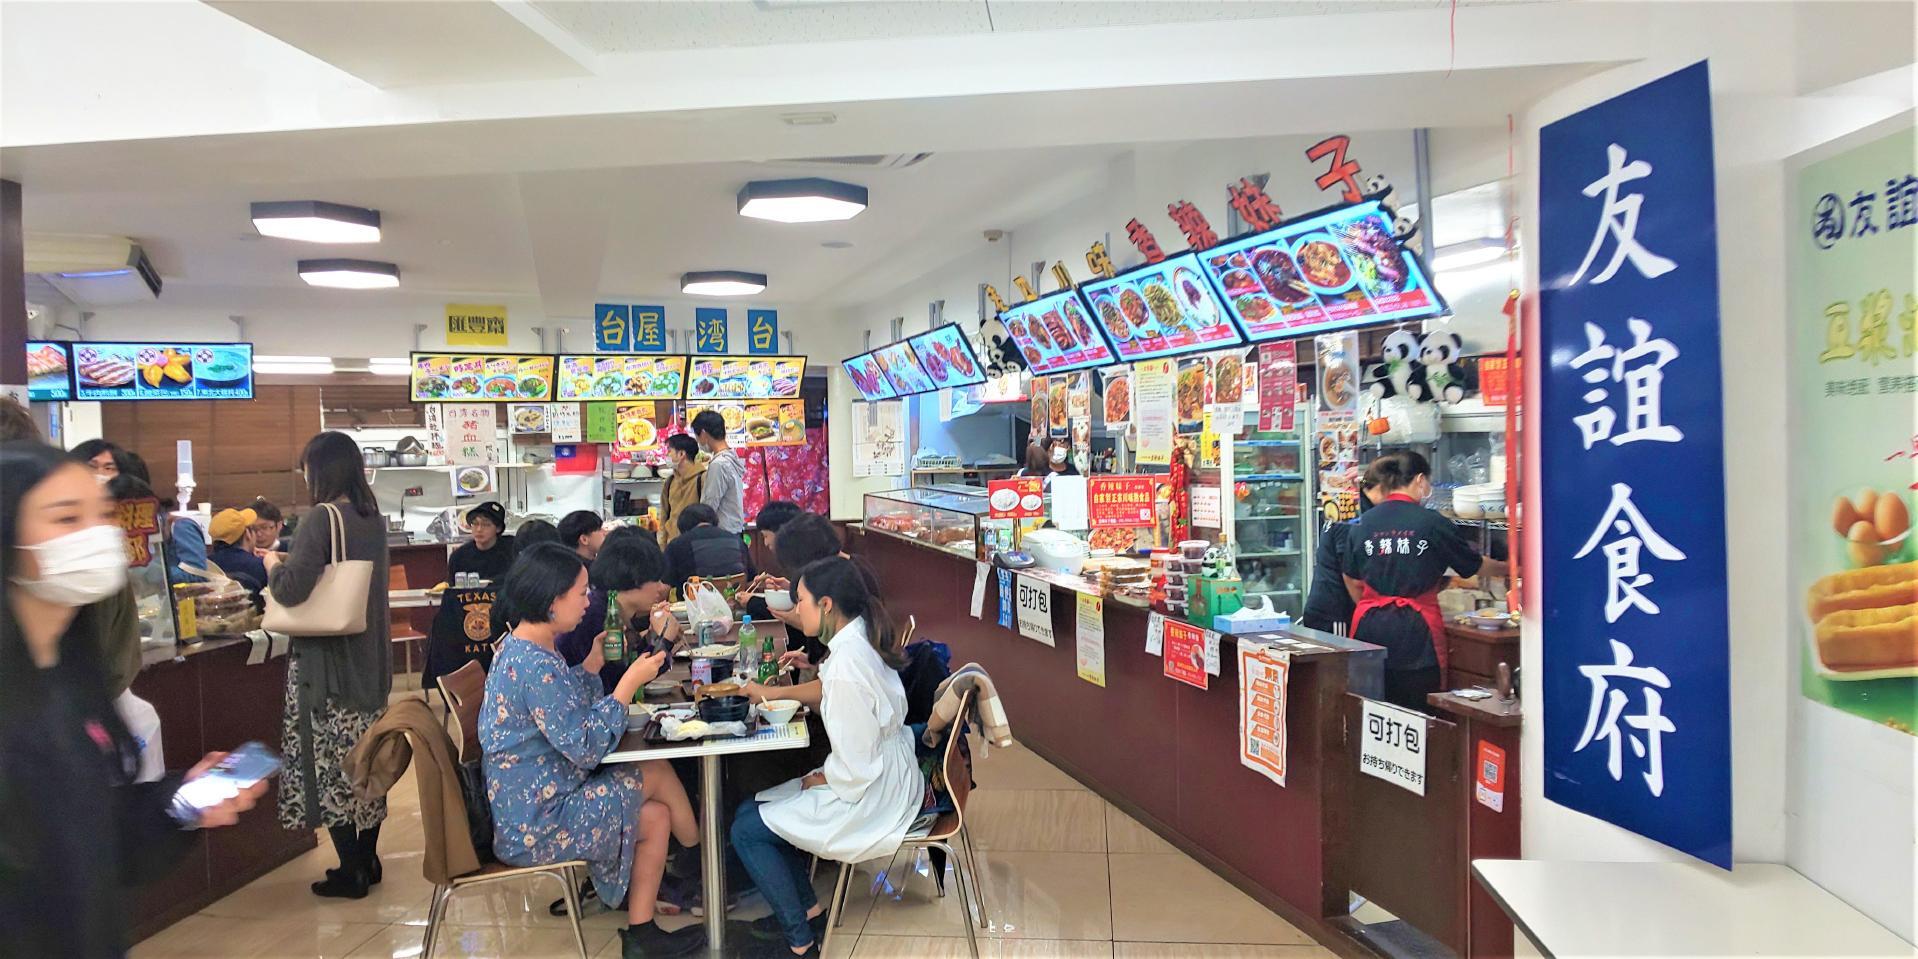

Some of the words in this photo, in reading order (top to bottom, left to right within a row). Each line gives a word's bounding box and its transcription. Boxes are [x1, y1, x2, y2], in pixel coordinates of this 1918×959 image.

[1568, 141, 1688, 798] 友誼食府
[457, 592, 497, 603] TEXAS
[1019, 584, 1048, 614] 可打包
[1368, 712, 1420, 754] 可打包
[1362, 752, 1424, 785] お持ち帰りできます
